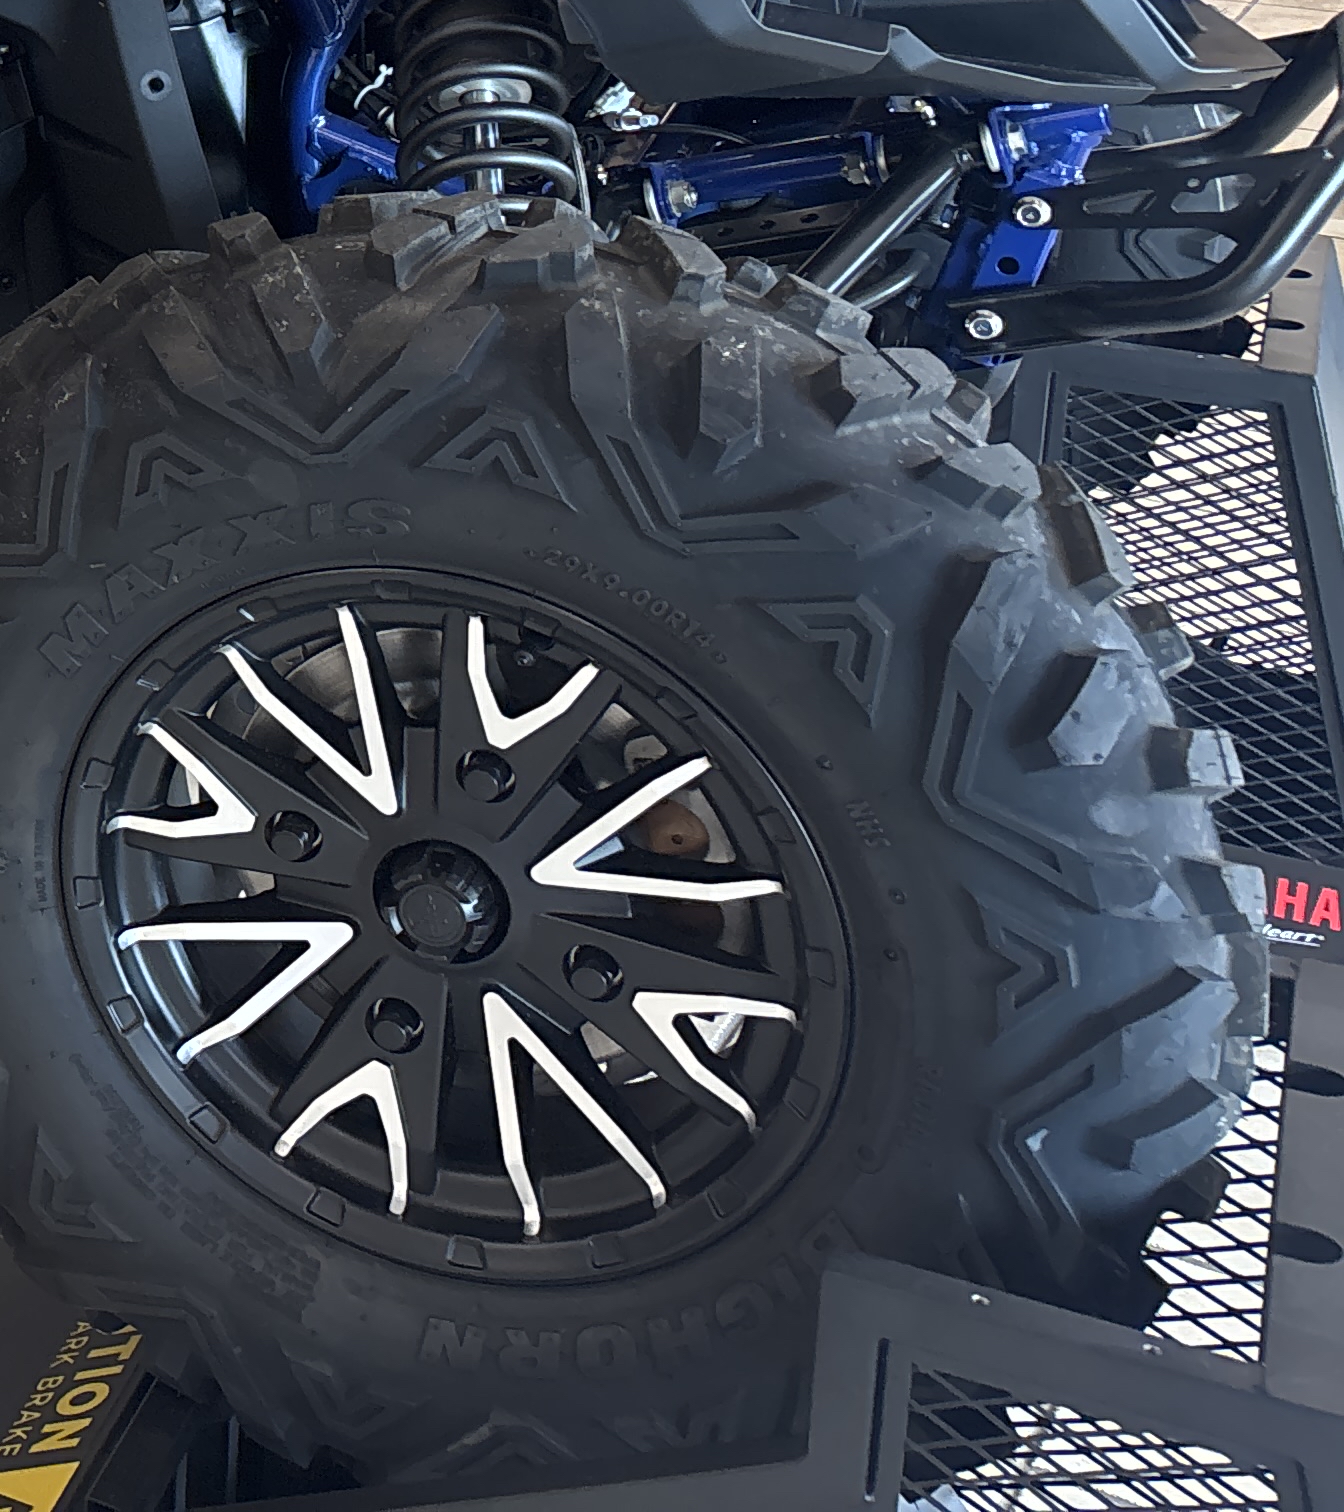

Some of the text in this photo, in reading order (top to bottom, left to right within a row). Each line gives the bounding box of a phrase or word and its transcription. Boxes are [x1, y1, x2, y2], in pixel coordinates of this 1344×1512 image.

[37, 497, 413, 679] MAXXIS
[844, 800, 893, 850] NHS
[49, 1320, 93, 1369] ARK
[27, 1326, 143, 1454] TION
